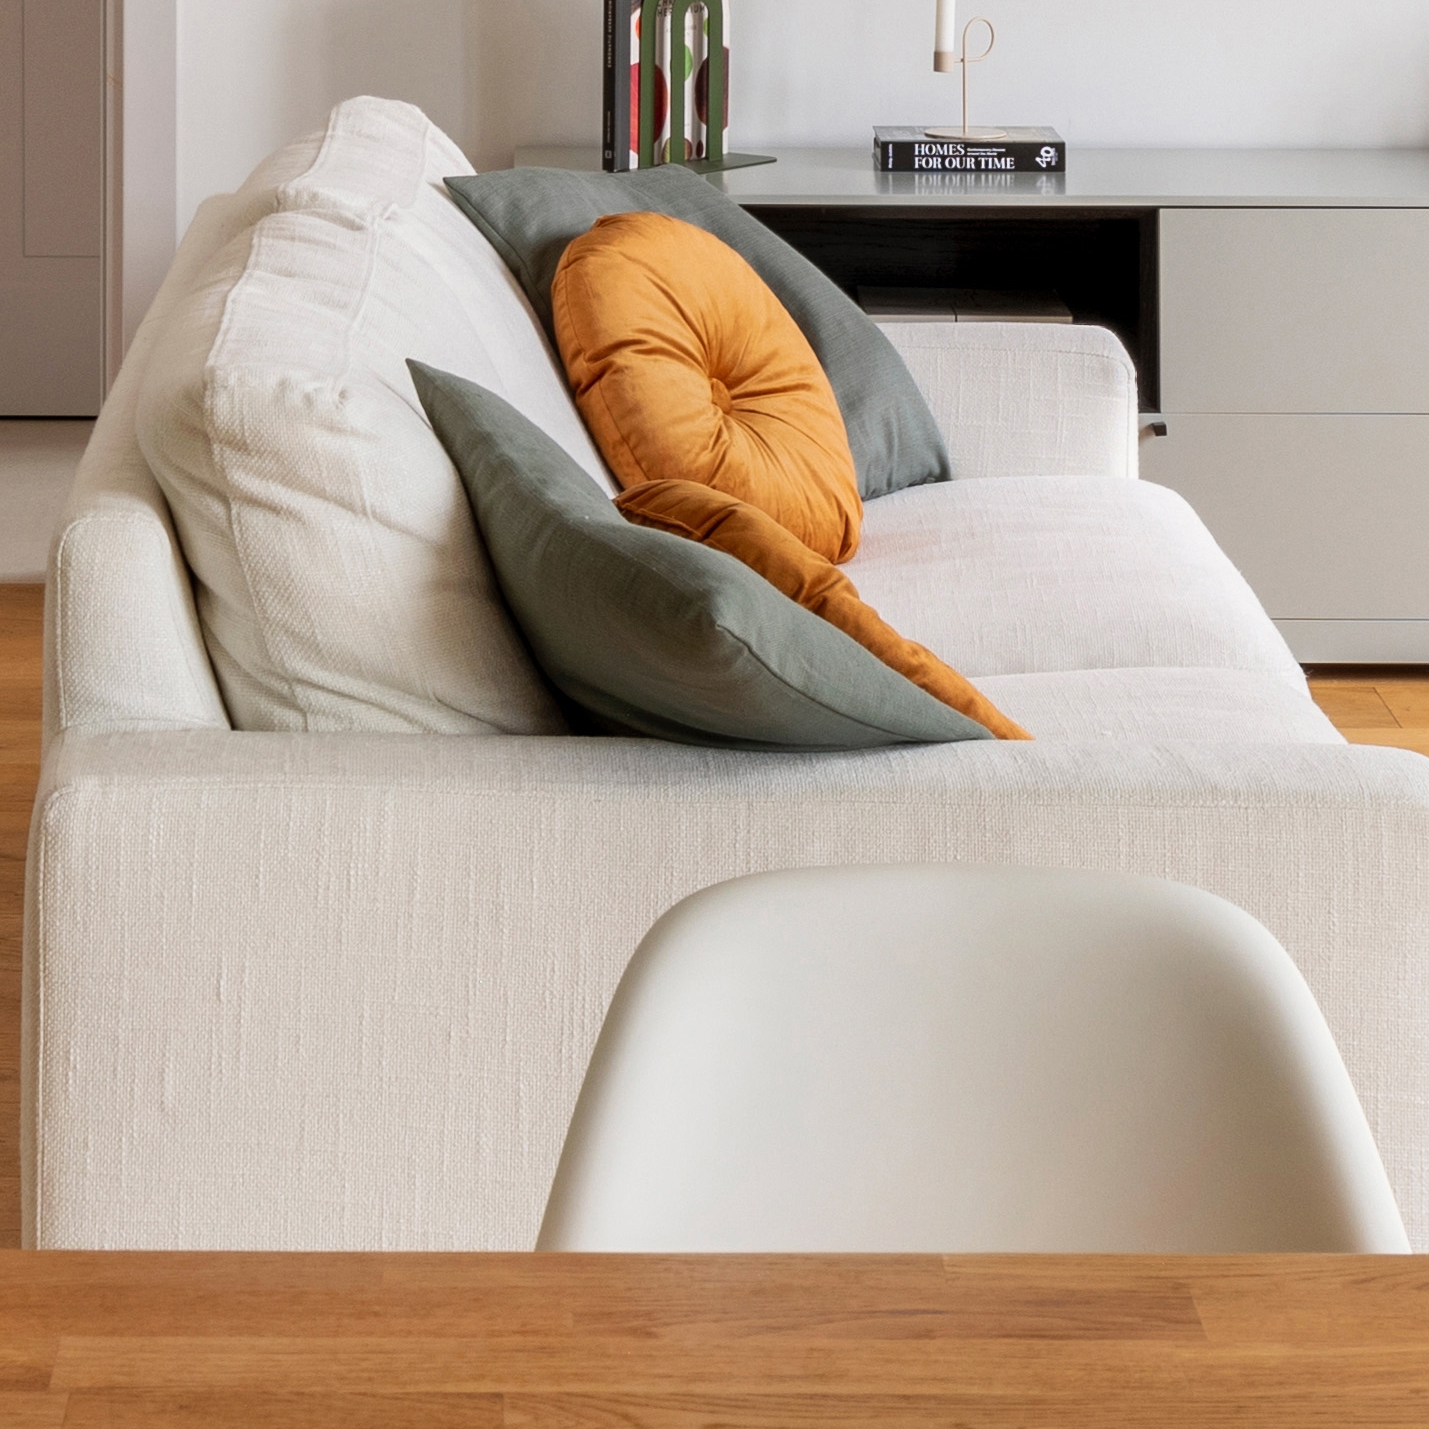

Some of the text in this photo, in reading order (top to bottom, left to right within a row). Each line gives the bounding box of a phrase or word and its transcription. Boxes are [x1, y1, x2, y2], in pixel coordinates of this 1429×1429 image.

[914, 144, 965, 156] HOMES
[914, 157, 1015, 169] FOR OUR TIME
